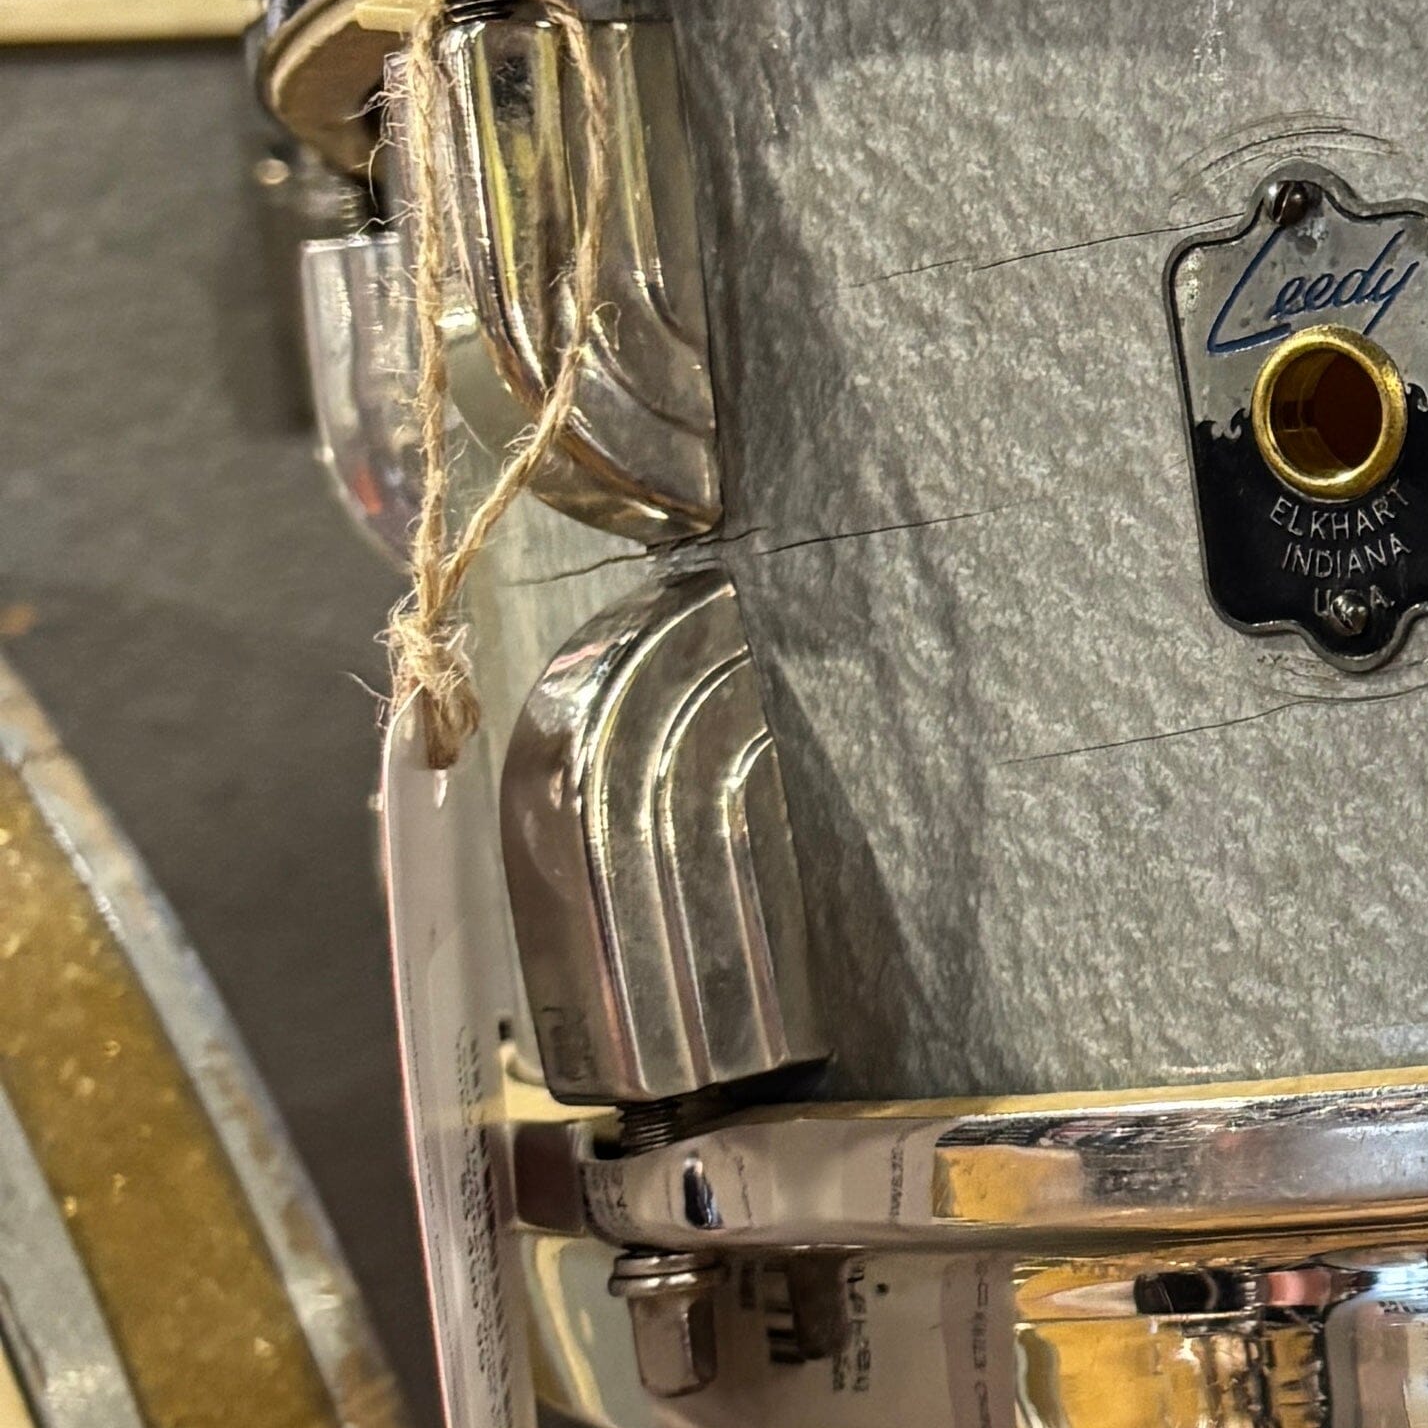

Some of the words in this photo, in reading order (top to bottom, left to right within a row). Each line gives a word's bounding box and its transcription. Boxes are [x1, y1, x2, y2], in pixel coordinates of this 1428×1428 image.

[1207, 225, 1420, 354] Leedy
[1269, 478, 1409, 540] ELKHART
[1281, 532, 1412, 578] INDIANA
